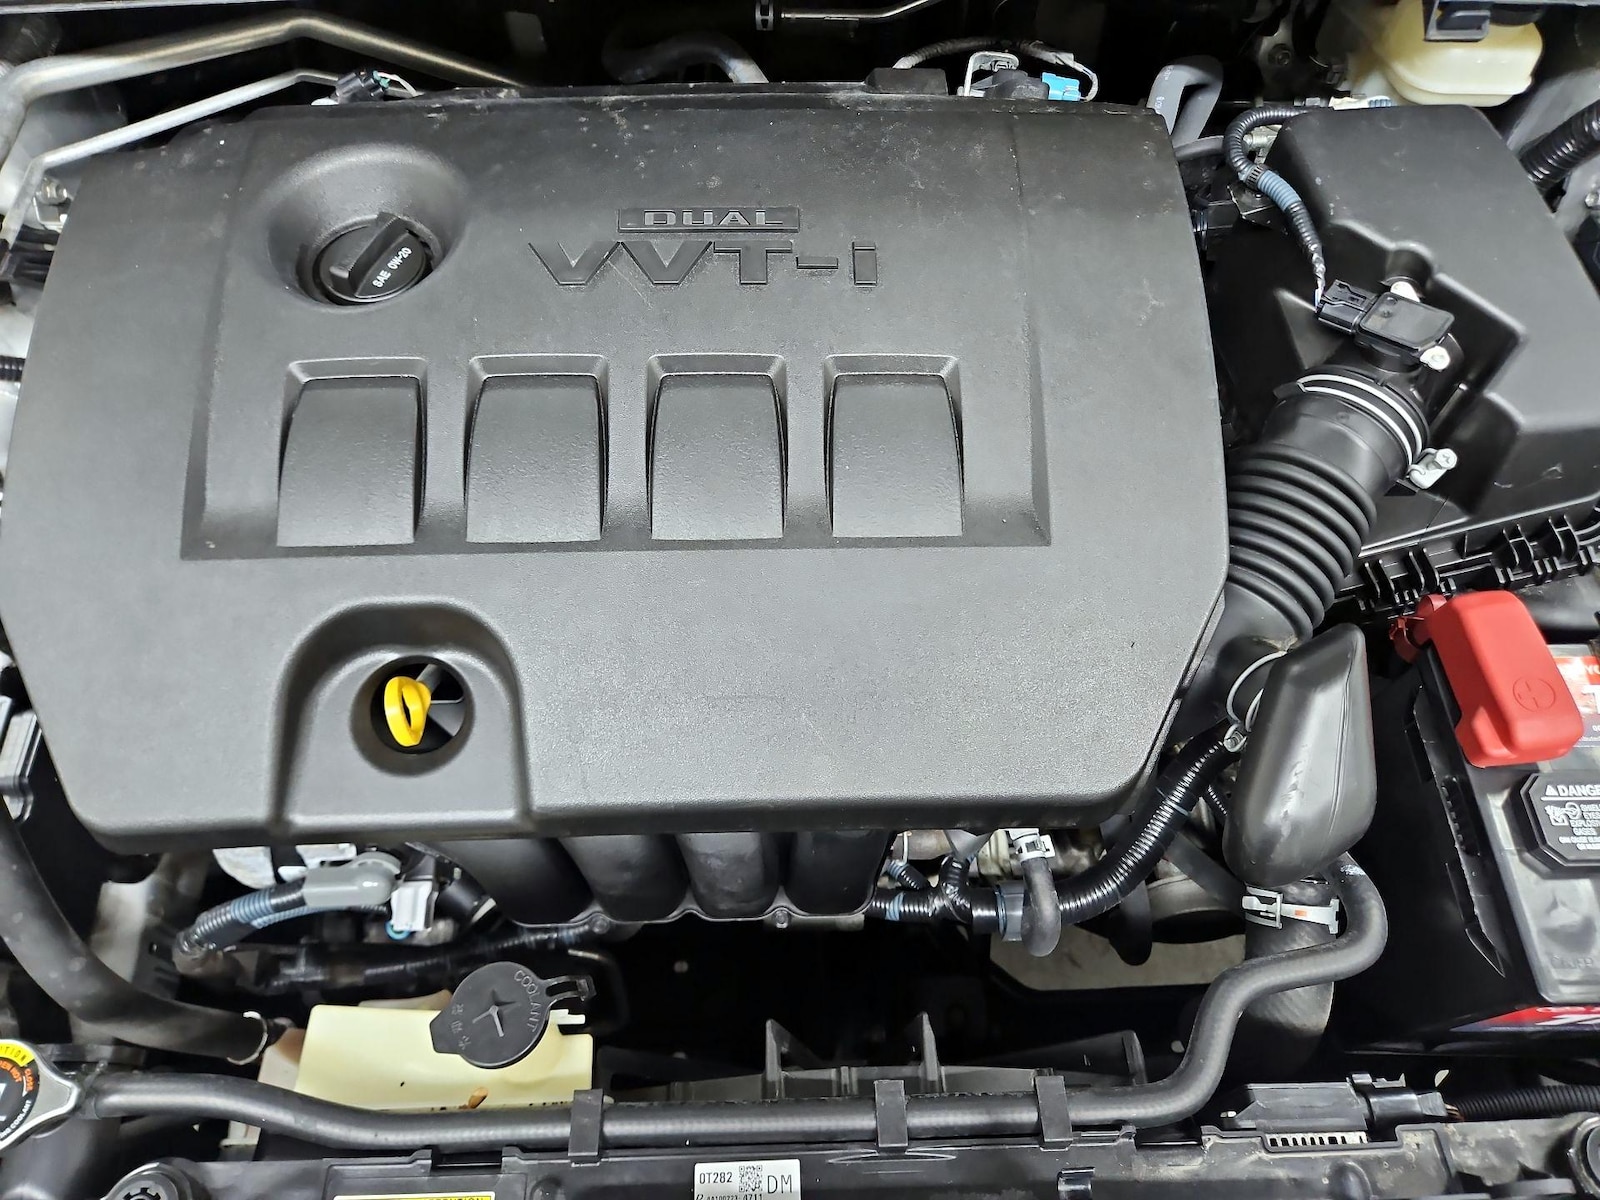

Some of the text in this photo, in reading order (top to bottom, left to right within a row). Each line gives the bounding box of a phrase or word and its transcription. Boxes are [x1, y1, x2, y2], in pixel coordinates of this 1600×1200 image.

[644, 209, 784, 226] DUAL
[528, 240, 878, 287] VVT-i
[372, 270, 392, 288] SAE
[514, 970, 541, 1033] COOLANT
[767, 1174, 793, 1194] DM
